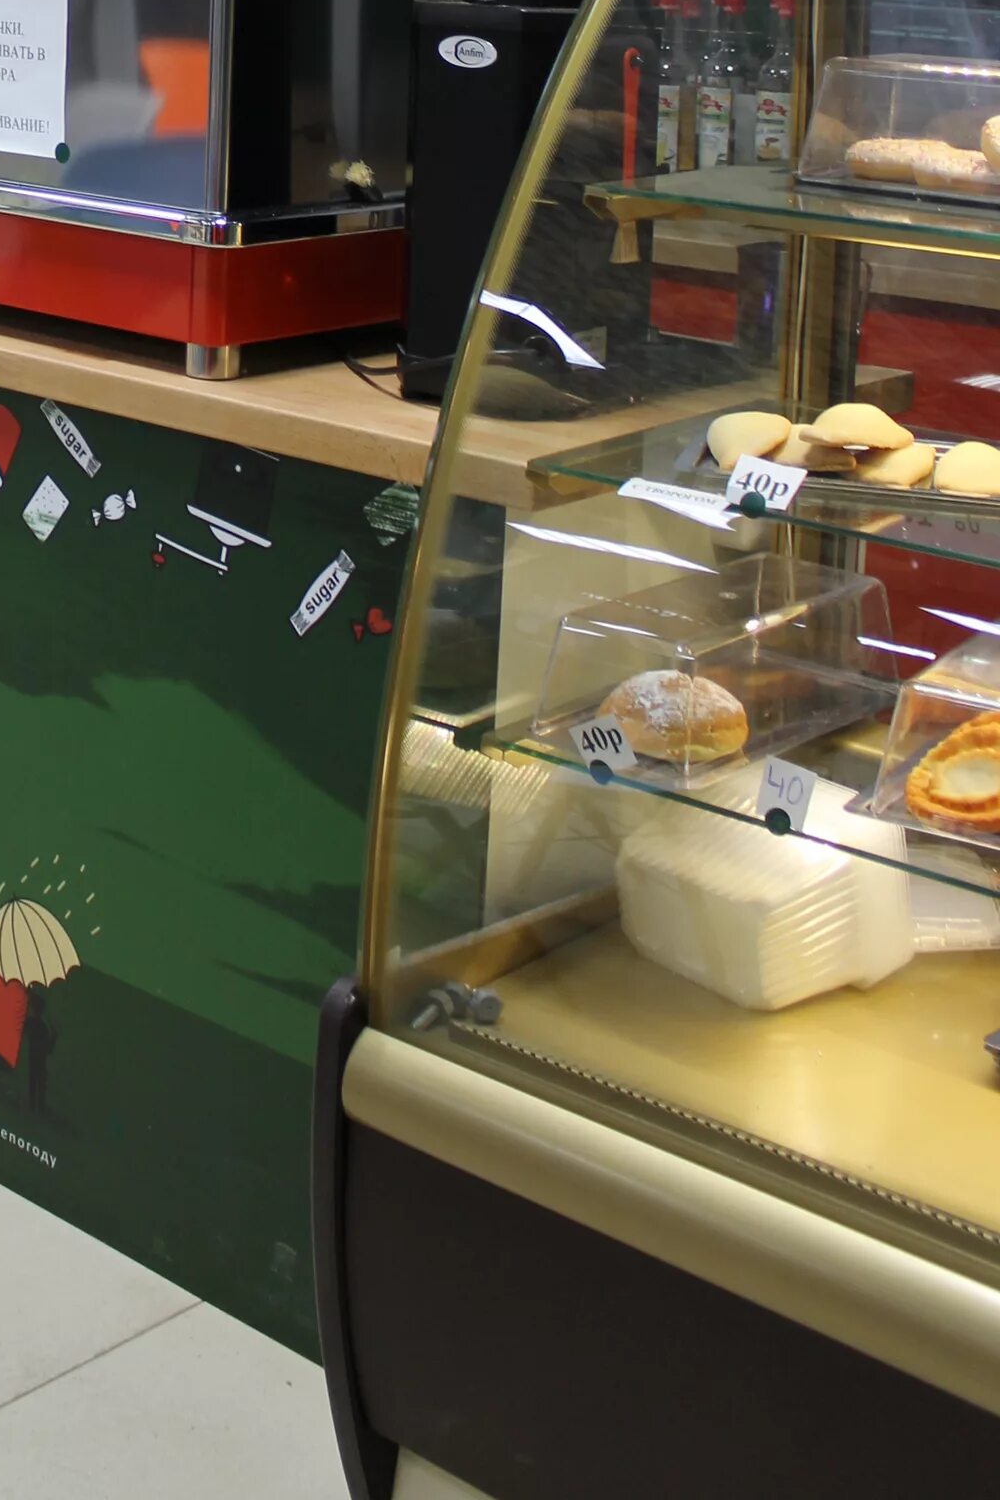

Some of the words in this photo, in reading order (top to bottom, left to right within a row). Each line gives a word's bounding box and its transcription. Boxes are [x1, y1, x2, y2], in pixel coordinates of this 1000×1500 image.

[36, 48, 46, 61] В
[459, 46, 484, 58] Anfim
[54, 412, 89, 461] sugar
[736, 471, 789, 502] 40р
[304, 567, 342, 616] sugar
[581, 725, 623, 755] 40р
[766, 765, 804, 806] 40
